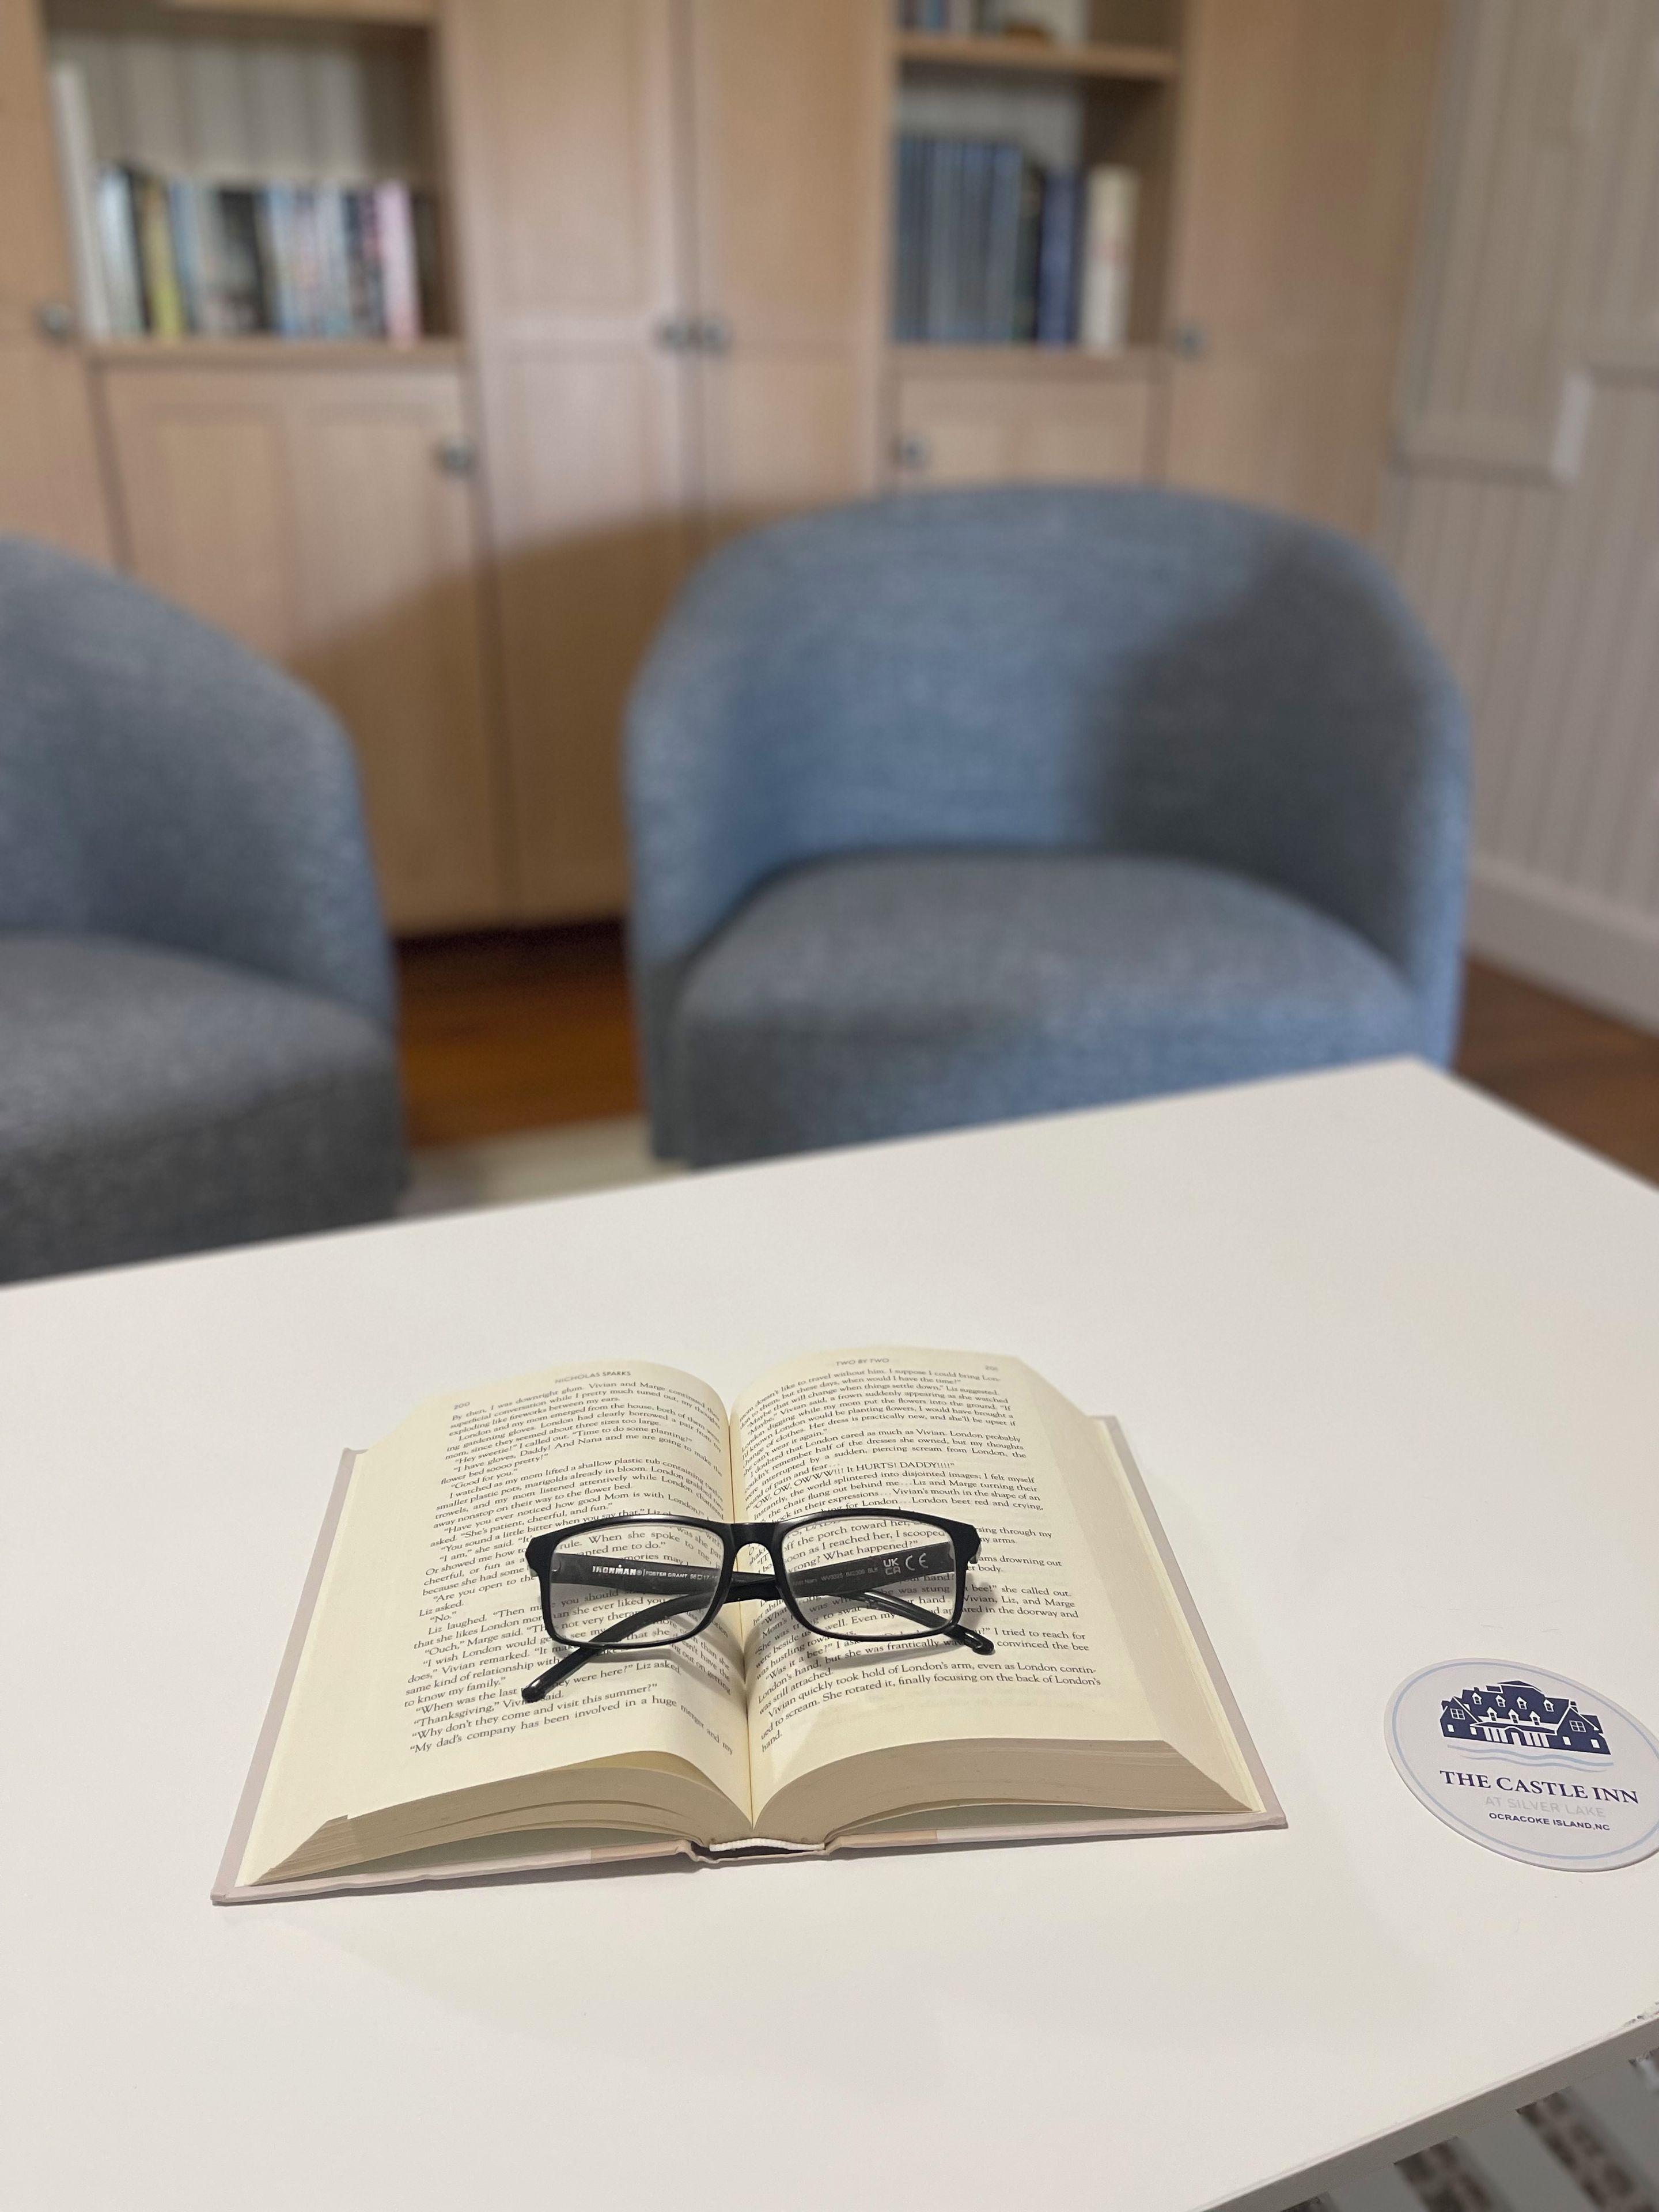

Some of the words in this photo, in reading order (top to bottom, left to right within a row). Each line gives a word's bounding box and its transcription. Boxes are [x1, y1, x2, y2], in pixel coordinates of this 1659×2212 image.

[555, 1372, 600, 1384] NICHOLAS
[454, 1402, 470, 1410] 200
[449, 1422, 490, 1437] exploding
[510, 1408, 547, 1419] fireworks
[549, 1402, 584, 1411] between
[856, 1461, 897, 1471] HURTS!
[797, 1536, 815, 1546] the
[817, 1527, 847, 1541] porch
[851, 1520, 887, 1532] toward
[809, 1544, 819, 1554] as
[822, 1542, 826, 1550] I
[829, 1532, 870, 1548] reached
[873, 1530, 892, 1540] her,
[823, 1550, 853, 1561] What
[856, 1540, 918, 1554] happened?”
[882, 1558, 899, 1567] UK
[885, 1566, 901, 1575] CA
[433, 1593, 454, 1602] “Are
[459, 1588, 475, 1598] you
[479, 1582, 502, 1592] open
[520, 1574, 537, 1582] the
[419, 1609, 433, 1617] Liz
[435, 1600, 464, 1613] asked.
[428, 1626, 442, 1635] Liz
[447, 1615, 487, 1630] laughed.
[493, 1608, 525, 1618] “Then
[430, 1611, 457, 1623] “No.”
[414, 1639, 434, 1649] that
[436, 1634, 453, 1643] she
[456, 1627, 478, 1638] likes
[480, 1620, 519, 1633] London
[522, 1615, 544, 1624] mor
[425, 1641, 465, 1655] “Ouch,”
[467, 1635, 498, 1646] Marge
[501, 1628, 523, 1638] said.
[1042, 1631, 1069, 1639] reach
[1072, 1631, 1086, 1640] for
[435, 1654, 458, 1665] wish
[463, 1645, 502, 1658] London
[506, 1636, 536, 1649] would
[997, 1640, 1048, 1649] convinced
[1071, 1642, 1089, 1651] bee
[406, 1684, 431, 1695] same
[434, 1676, 457, 1688] kind
[460, 1672, 471, 1681] of
[473, 1661, 534, 1679] relationship
[537, 1657, 560, 1666] with
[408, 1670, 438, 1684] does,”
[442, 1661, 475, 1674] Vivian
[479, 1652, 529, 1666] remarked.
[573, 1673, 597, 1684] were
[600, 1664, 633, 1678] here?”
[636, 1662, 651, 1670] Liz
[654, 1660, 681, 1675] asked
[416, 1702, 453, 1714] “When
[457, 1696, 475, 1706] was
[479, 1690, 495, 1700] the
[499, 1688, 517, 1696] last
[418, 1692, 446, 1704] know
[449, 1688, 464, 1696] my
[467, 1677, 506, 1692] family.”
[759, 1702, 772, 1715] was
[773, 1687, 788, 1703] still
[790, 1668, 834, 1691] attached.
[768, 1697, 796, 1718] Vivian
[798, 1680, 833, 1700] quickly
[836, 1673, 859, 1685] took
[862, 1667, 885, 1679] hold
[888, 1665, 899, 1675] of
[902, 1661, 949, 1673] London’s
[1017, 1662, 1057, 1672] London
[1060, 1666, 1096, 1674] contin-
[775, 1717, 784, 1726] to
[785, 1700, 820, 1719] scream.
[823, 1691, 842, 1702] She
[845, 1680, 881, 1695] rotated
[899, 1675, 931, 1685] finally
[934, 1673, 978, 1682] focusing
[997, 1673, 1013, 1682] the
[1016, 1673, 1040, 1683] back
[1043, 1675, 1053, 1683] of
[1055, 1675, 1101, 1685] London’s
[412, 1728, 442, 1738] “Why
[446, 1720, 472, 1733] don’t
[475, 1717, 498, 1726] they
[502, 1711, 531, 1721] come
[533, 1704, 554, 1715] and
[556, 1699, 579, 1710] visit
[582, 1696, 602, 1705] this
[605, 1683, 657, 1699] summer?”
[414, 1702, 499, 1727] “Thanksgiving,”
[410, 1743, 432, 1753] “My
[437, 1734, 462, 1748] dad’s
[467, 1725, 516, 1740] company
[521, 1721, 539, 1730] has
[544, 1714, 569, 1725] been
[575, 1700, 620, 1718] involved
[626, 1699, 636, 1707] in
[652, 1695, 677, 1707] huge
[681, 1705, 704, 1729] merger
[707, 1728, 719, 1743] and
[723, 1742, 733, 1755] my
[762, 1730, 783, 1752] hand.
[1440, 1770, 1491, 1789] THE
[1496, 1777, 1588, 1799] CASTLE
[1591, 1786, 1639, 1804] INN
[1484, 1796, 1502, 1806] AT
[1508, 1798, 1559, 1813] SILVER
[1566, 1804, 1605, 1818] LAKE
[1489, 1812, 1550, 1825] OCRACOKE
[1553, 1820, 1610, 1831] ISLAND,NC
